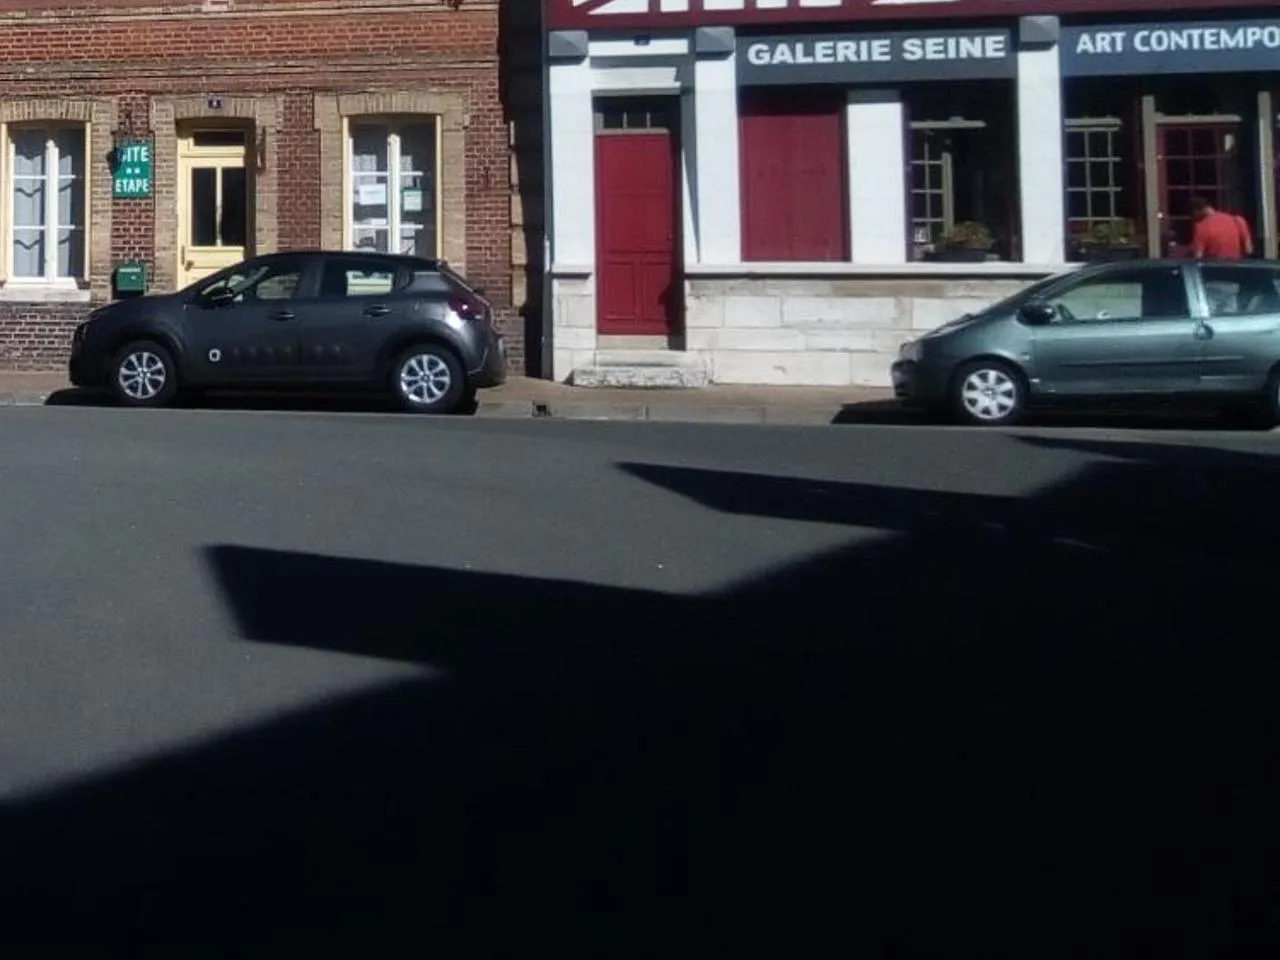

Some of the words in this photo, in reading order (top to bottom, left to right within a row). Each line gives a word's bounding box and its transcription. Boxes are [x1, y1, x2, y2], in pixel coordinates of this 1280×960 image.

[747, 39, 891, 65] GALERIE
[902, 35, 1006, 61] SEINE
[1076, 32, 1127, 54] ART
[1133, 26, 1280, 52] CONTEMPO
[115, 179, 149, 192] ETAPE
